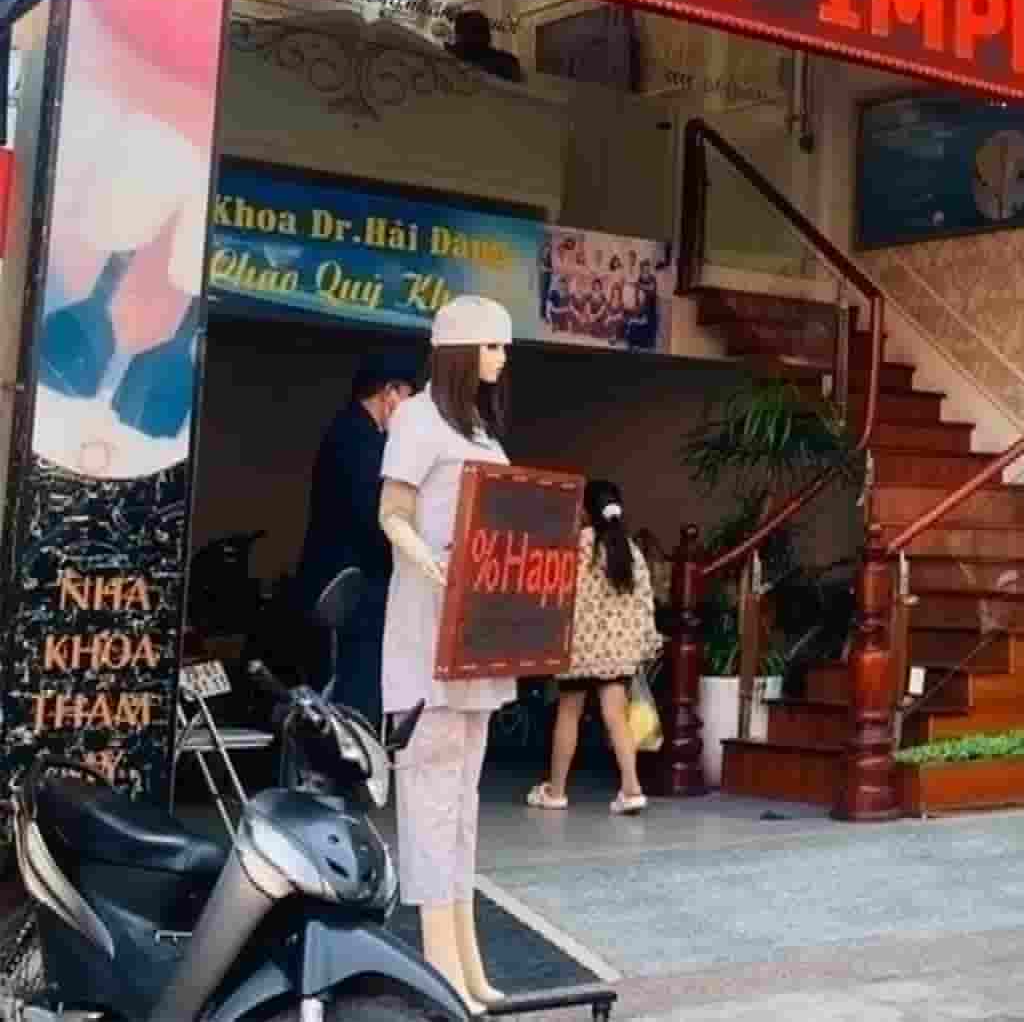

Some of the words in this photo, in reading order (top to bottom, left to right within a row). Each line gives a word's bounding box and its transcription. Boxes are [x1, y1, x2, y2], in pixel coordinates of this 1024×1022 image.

[212, 194, 298, 236] Khoa
[402, 272, 449, 312] Kh
[58, 566, 150, 612] NHA
[43, 632, 160, 672] KHOA
